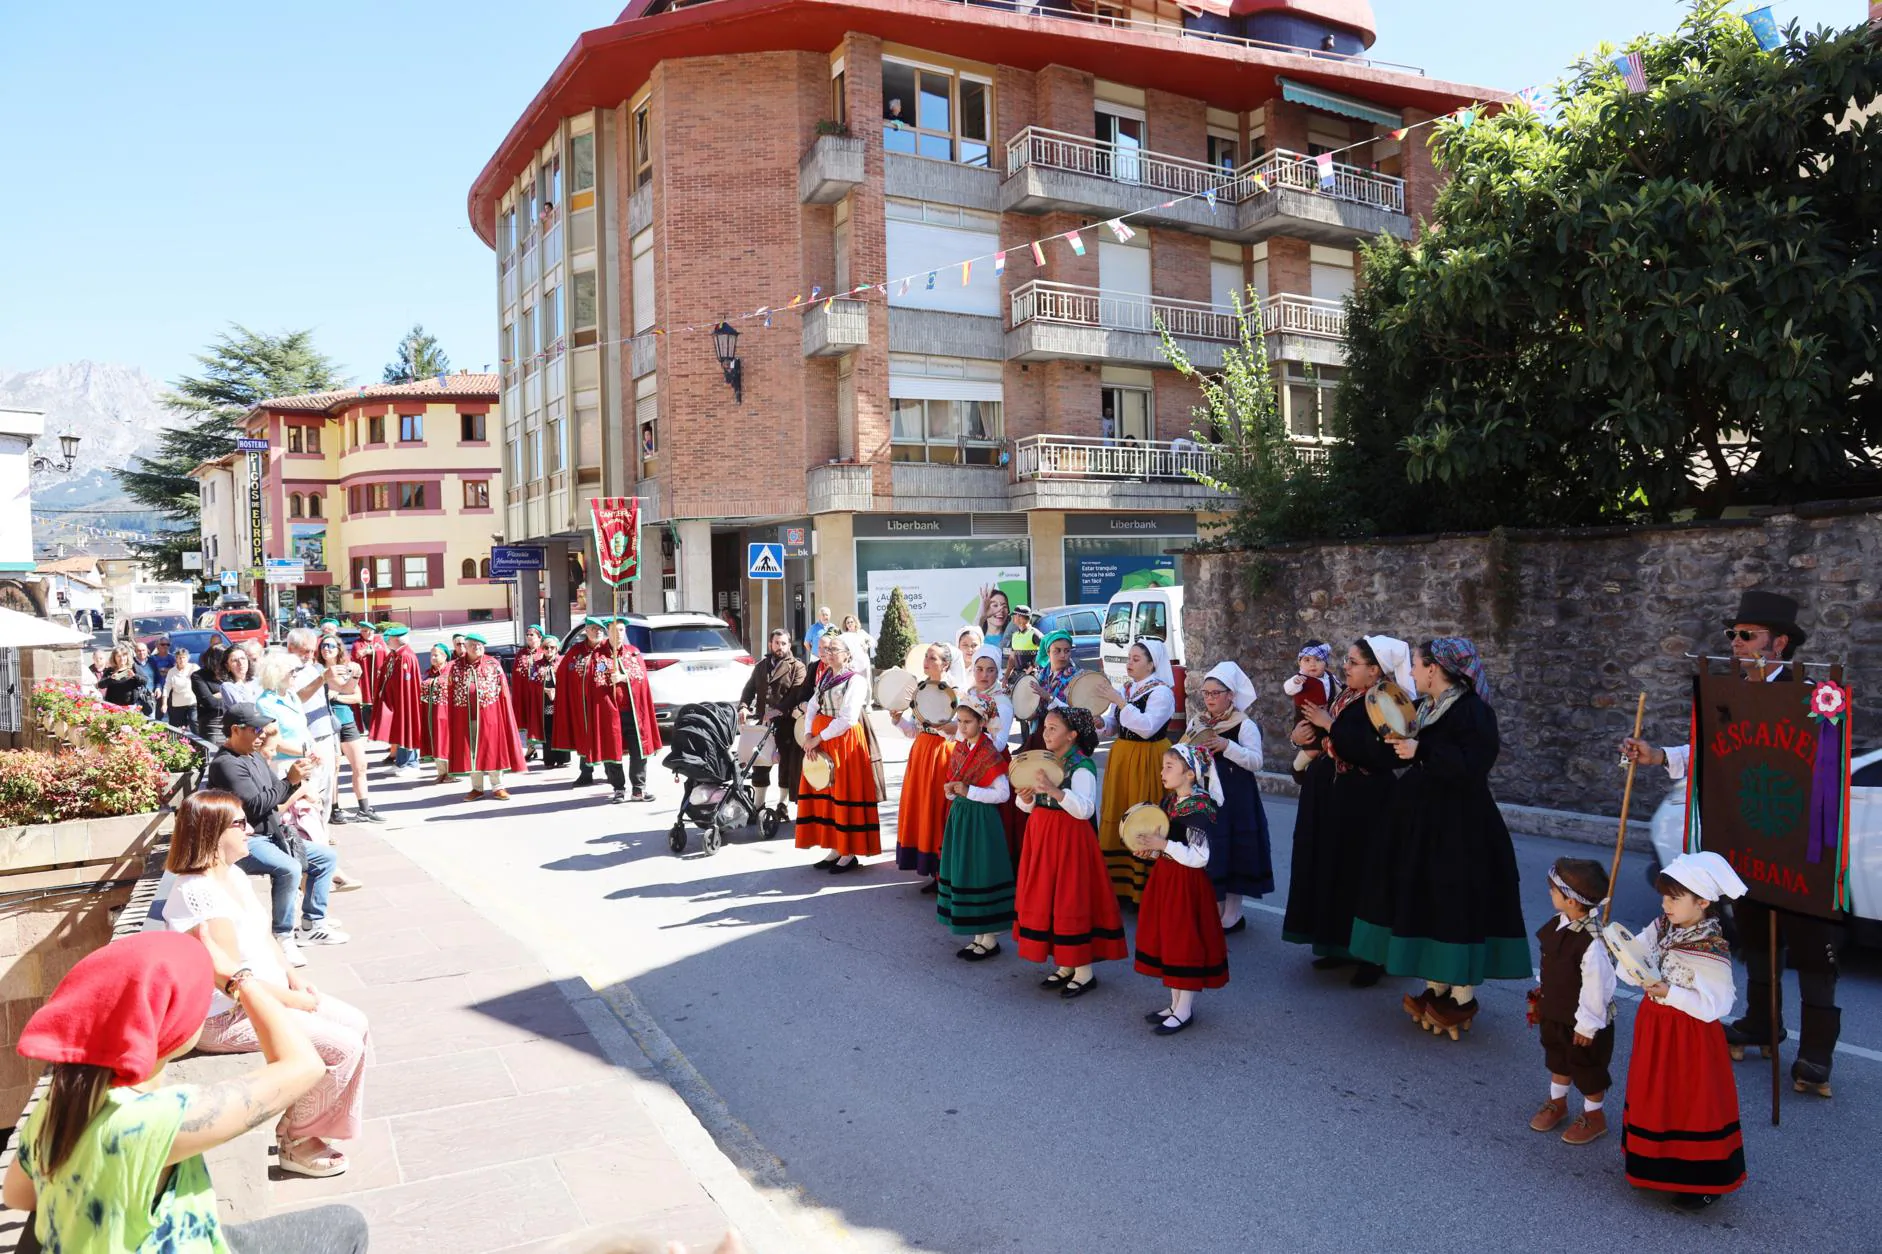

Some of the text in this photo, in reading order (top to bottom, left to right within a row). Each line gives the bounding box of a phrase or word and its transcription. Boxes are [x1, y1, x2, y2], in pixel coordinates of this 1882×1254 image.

[250, 452, 259, 500] PICOS
[887, 520, 940, 530] Liberbank
[1110, 519, 1157, 529] Liberbank
[251, 509, 262, 566] EUROPA
[1095, 565, 1118, 573] tranquilo
